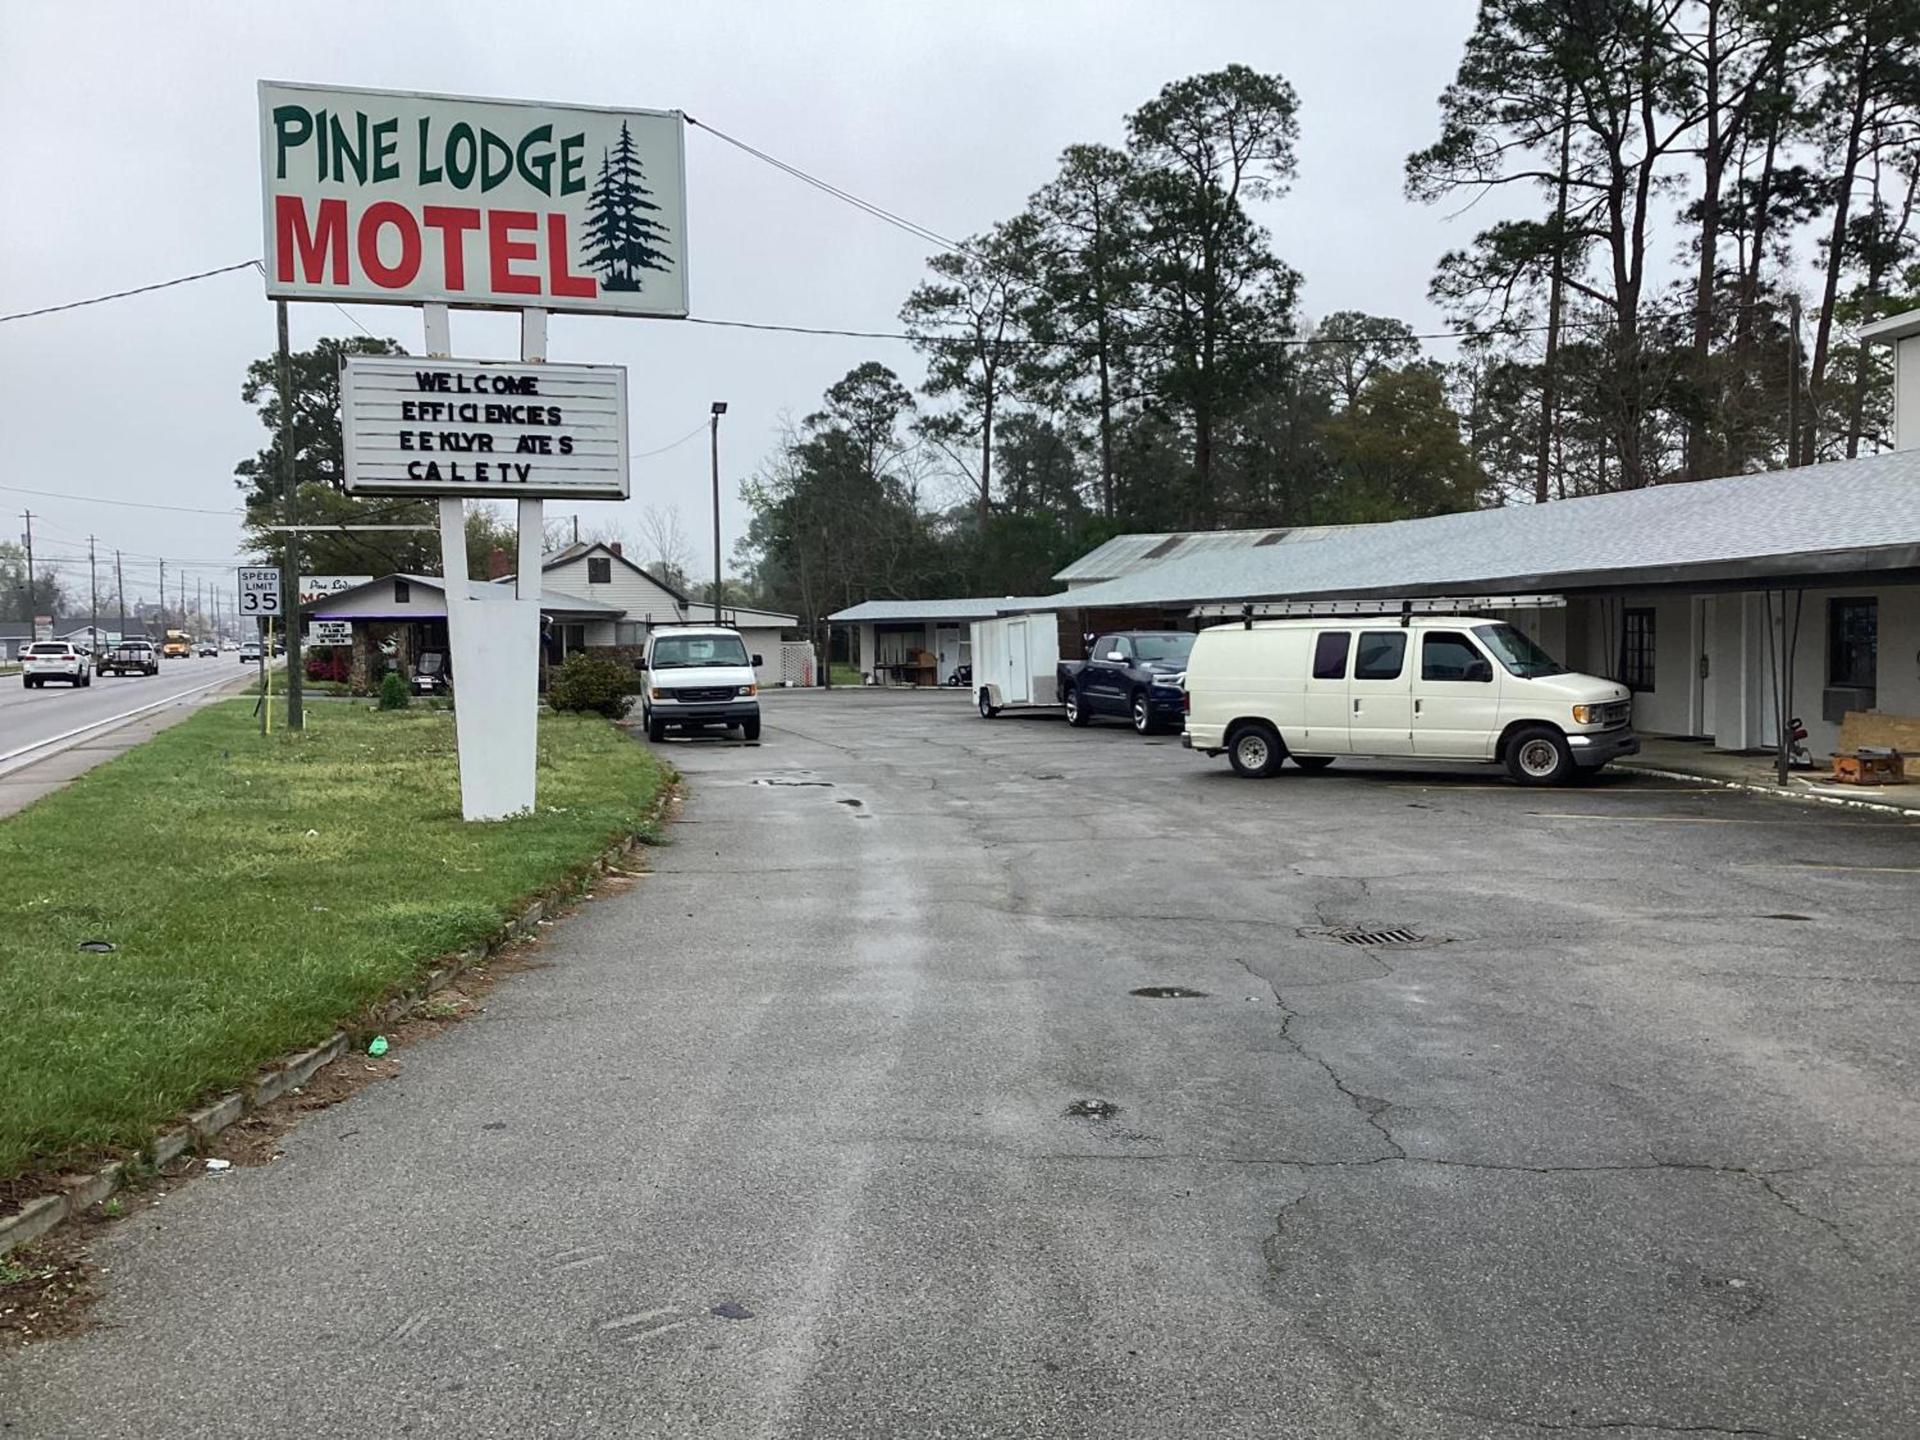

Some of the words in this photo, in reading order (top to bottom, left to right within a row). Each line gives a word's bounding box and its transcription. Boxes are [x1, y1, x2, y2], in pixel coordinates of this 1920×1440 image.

[273, 105, 400, 186] PINE
[418, 116, 587, 198] LODGE
[275, 195, 597, 299] MOTEL
[415, 371, 539, 395] WELCOME
[241, 572, 278, 581] SPEED
[246, 582, 273, 591] LIMIT
[244, 593, 278, 610] 35
